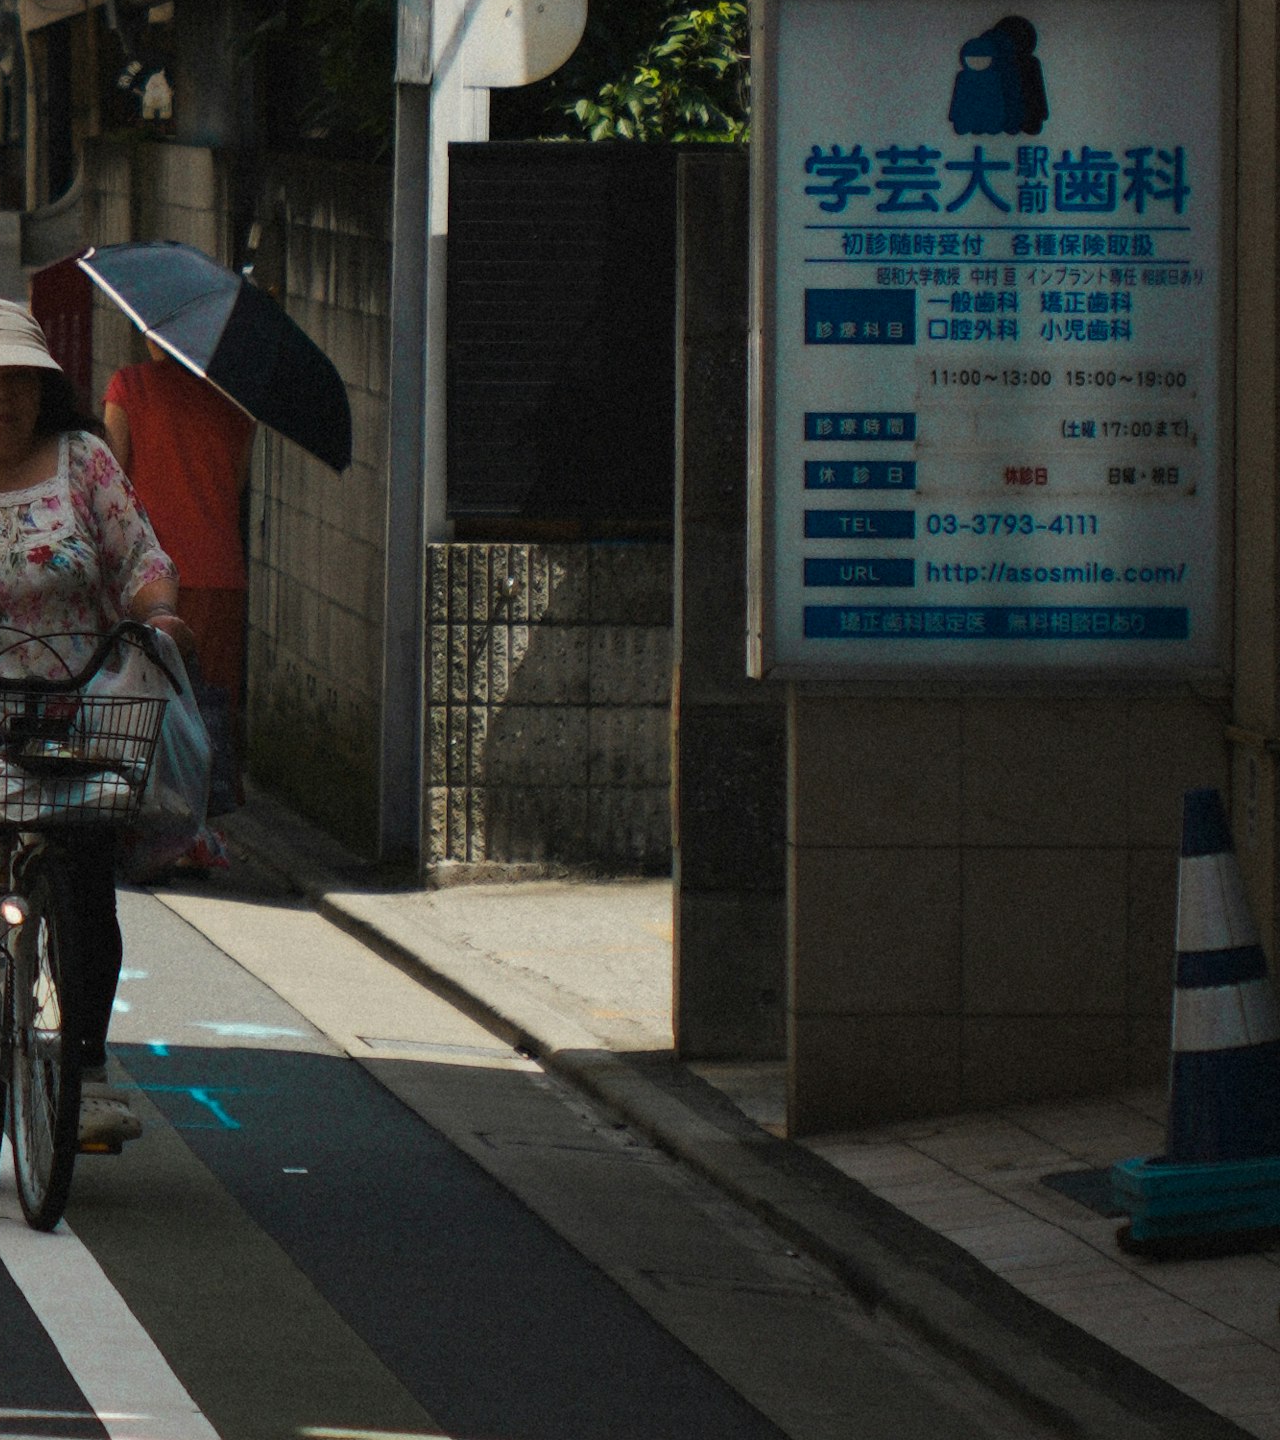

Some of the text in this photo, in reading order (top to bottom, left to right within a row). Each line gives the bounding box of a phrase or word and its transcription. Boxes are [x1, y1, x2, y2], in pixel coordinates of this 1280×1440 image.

[803, 143, 1192, 215] 学芸大駅前歯科
[842, 232, 1155, 258] 初診随時受付 各種保険取扱
[876, 266, 960, 287] 昭和大学教授
[971, 267, 999, 287] 中村
[1026, 267, 1138, 287] インプラント専任
[928, 291, 1133, 314] 一般歯科 矯正歯科
[815, 321, 905, 338] 診療科目
[928, 318, 1133, 342] 口腔外科 小児歯科
[815, 418, 905, 435] 診療時間
[818, 467, 905, 483] 休診日
[1004, 467, 1180, 486] 休診日 日曜・祝日
[839, 514, 1099, 536] TEL 03-3793-4111
[839, 562, 1186, 587] URL http://asosmile.com/
[1008, 611, 1147, 633] 無料相談日あり
